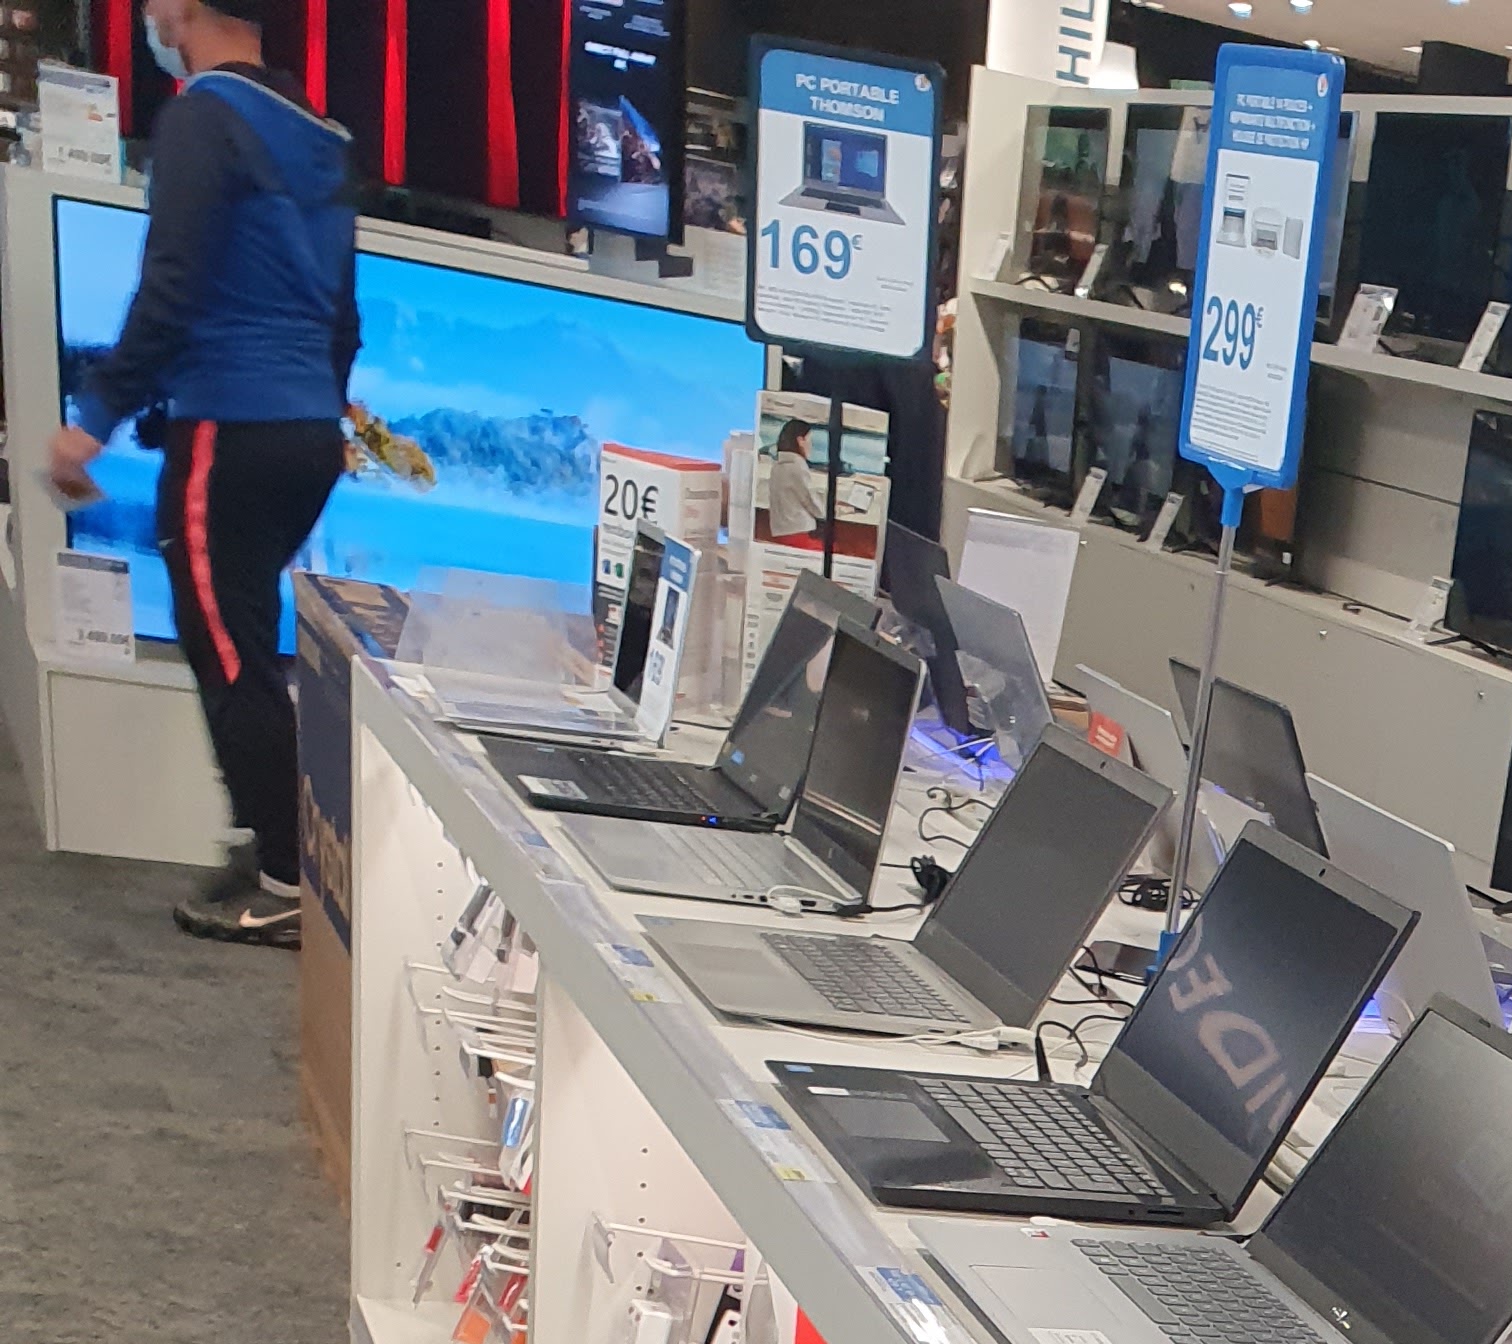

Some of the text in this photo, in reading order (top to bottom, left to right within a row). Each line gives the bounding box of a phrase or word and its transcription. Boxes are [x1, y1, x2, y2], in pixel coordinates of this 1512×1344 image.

[796, 74, 899, 104] PC PORTABLE
[810, 96, 885, 122] THOMSON
